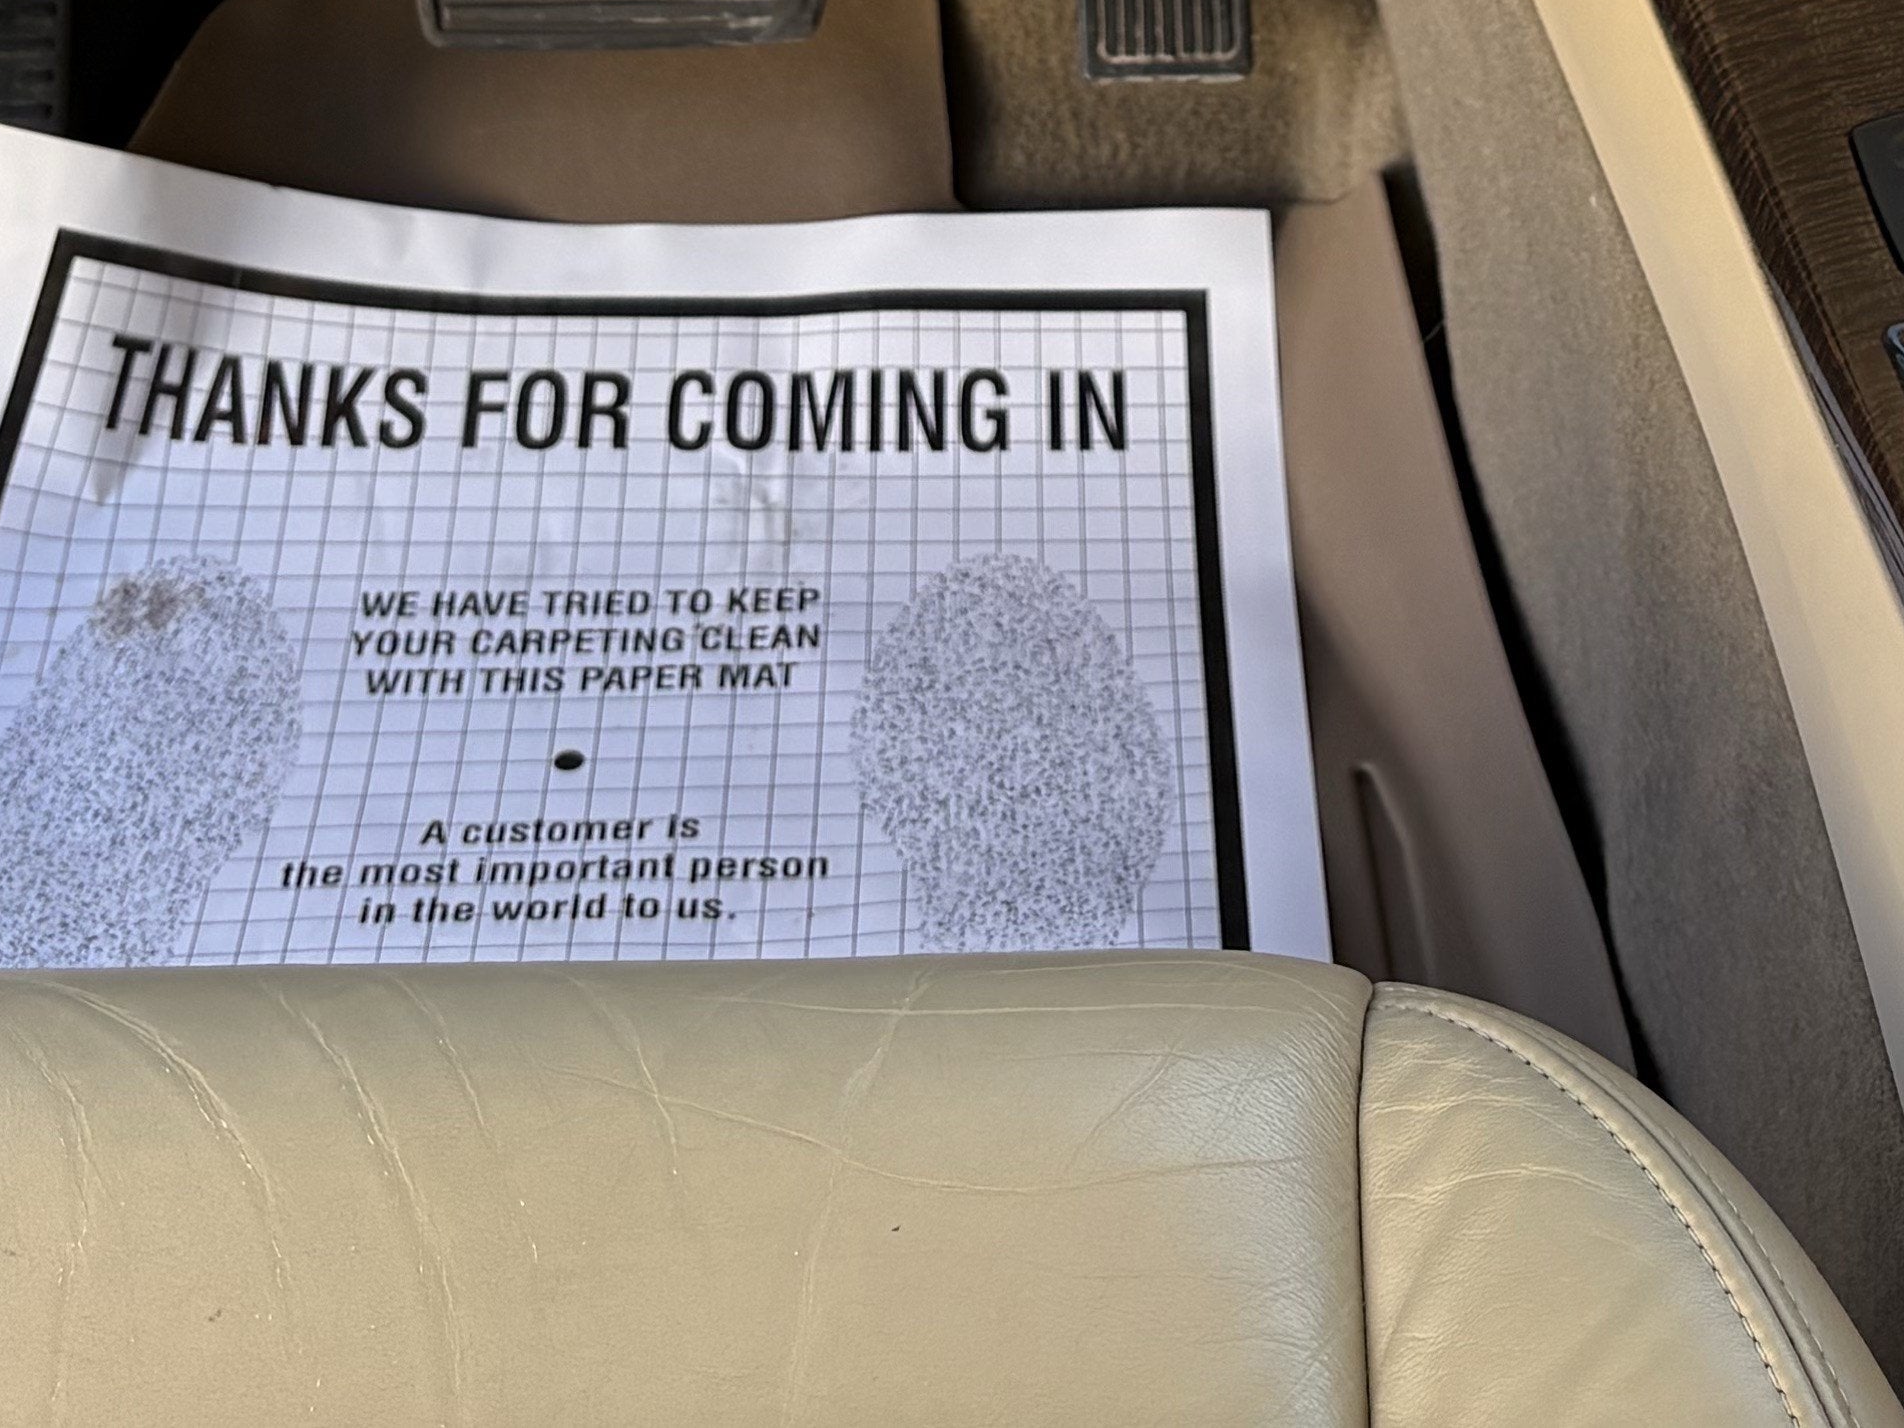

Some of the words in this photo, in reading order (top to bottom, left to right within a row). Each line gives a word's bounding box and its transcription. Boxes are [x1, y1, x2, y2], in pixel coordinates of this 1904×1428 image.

[108, 334, 426, 449] THANKS
[461, 368, 629, 452] FOR
[667, 367, 1010, 454] COMING
[1047, 368, 1129, 452] IN
[361, 590, 418, 618] WE
[432, 590, 529, 617] HAVE
[542, 589, 652, 616] TRIED
[667, 588, 713, 614] TO
[727, 587, 821, 614] KEEP
[350, 628, 456, 657] YOUR
[471, 626, 685, 655] CARPETING
[699, 624, 821, 651] CLEAN
[366, 666, 463, 695] WITH
[479, 665, 564, 693] THIS
[580, 664, 703, 692] PAPER
[717, 662, 799, 690] MAT
[420, 820, 446, 846] A
[462, 815, 652, 845] customer
[281, 860, 343, 889] the
[360, 858, 460, 885] most
[473, 853, 675, 889] important
[688, 853, 830, 884] person
[359, 898, 395, 924] in
[412, 896, 475, 923] the
[492, 893, 607, 921] world
[625, 893, 659, 919] to
[677, 896, 737, 920] us.
